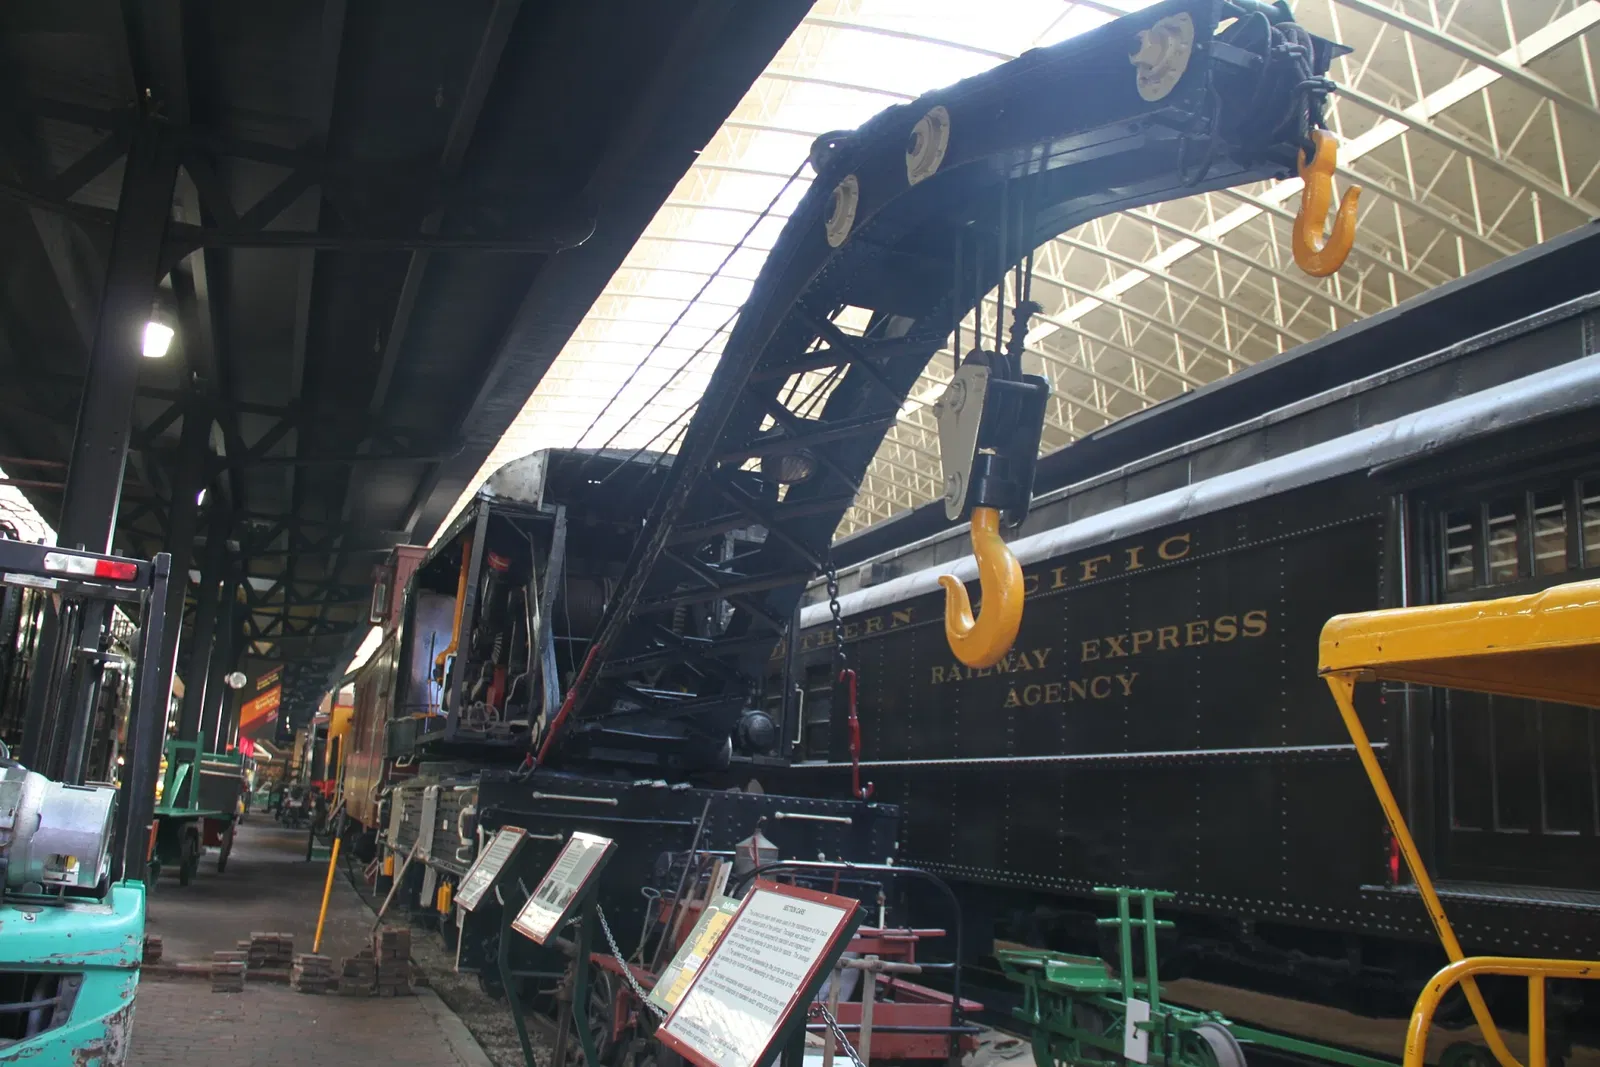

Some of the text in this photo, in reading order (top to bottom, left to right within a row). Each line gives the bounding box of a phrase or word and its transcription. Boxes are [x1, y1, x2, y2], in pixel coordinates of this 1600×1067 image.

[770, 533, 1192, 659] THERN CIFIC
[1080, 610, 1268, 662] EXPRESS
[1003, 672, 1139, 708] AGENCY
